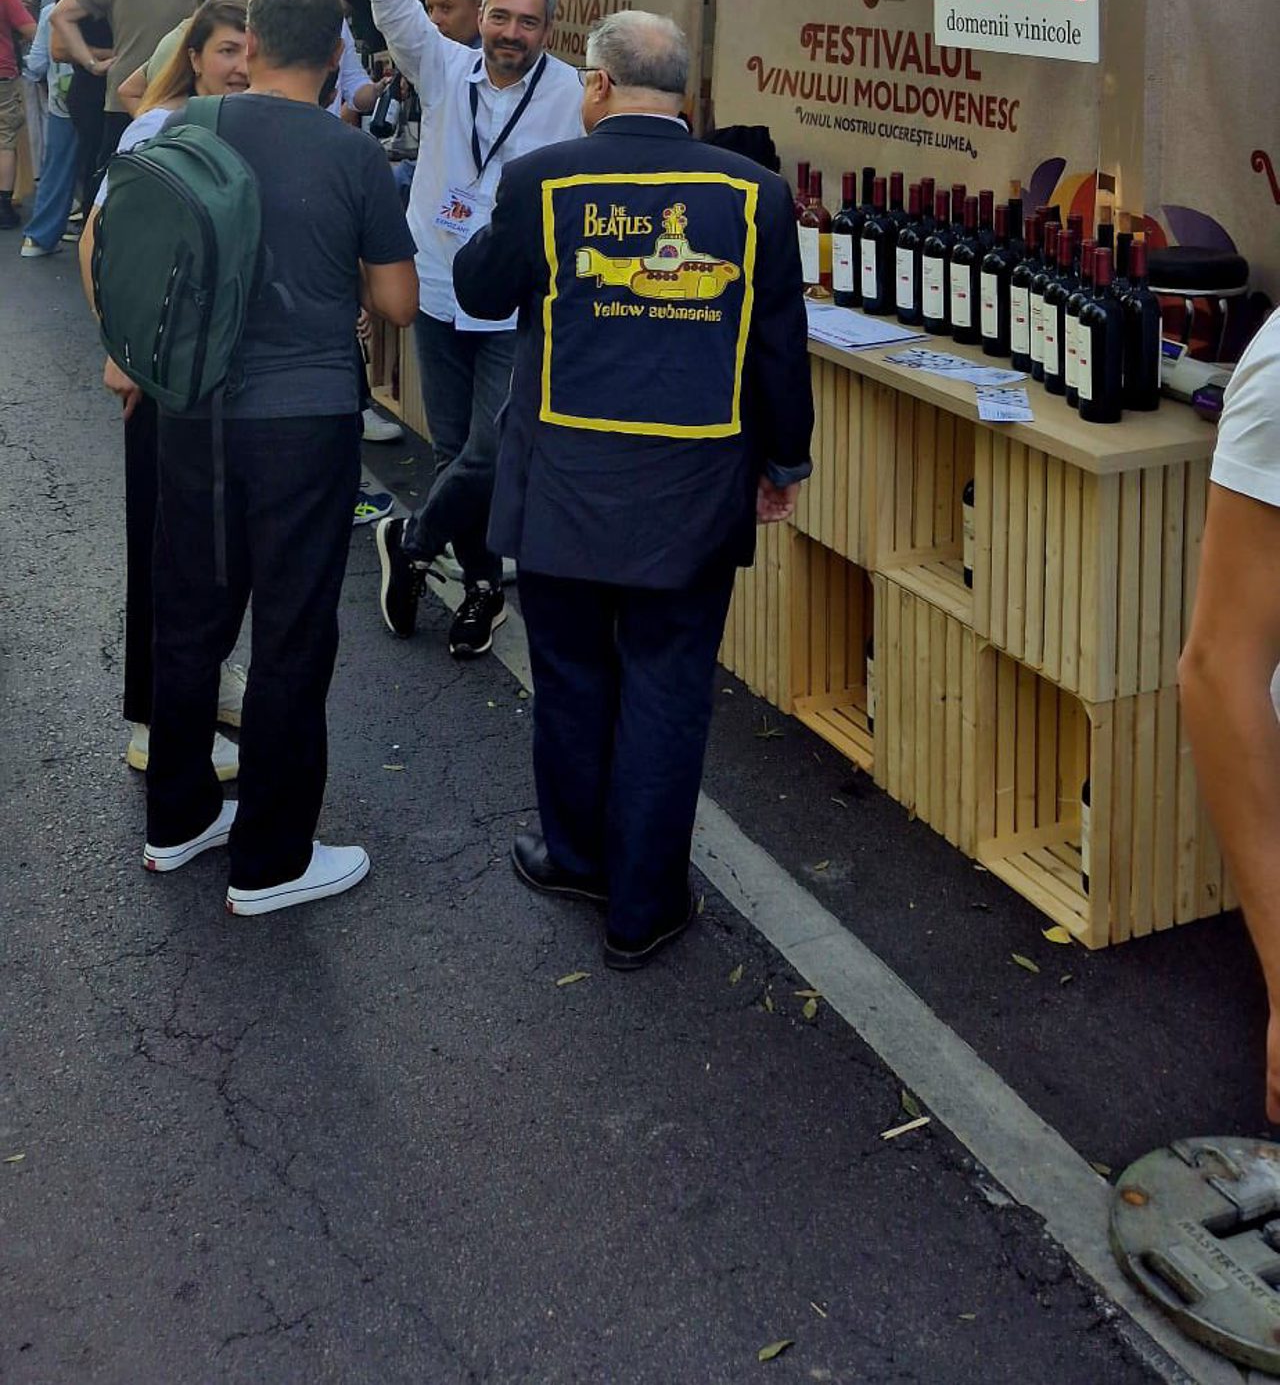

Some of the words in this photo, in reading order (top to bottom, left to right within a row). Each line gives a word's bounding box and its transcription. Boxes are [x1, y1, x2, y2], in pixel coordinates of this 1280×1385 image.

[946, 9, 1009, 37] domenii
[1014, 16, 1081, 45] vinicole
[801, 23, 981, 81] FESTIVALUL
[747, 56, 848, 104] VINULUI
[854, 78, 1020, 133] MOLDOVENESC
[796, 106, 832, 129] VINUL
[834, 115, 876, 136] NOSTRU
[935, 134, 977, 159] LUMEA
[584, 202, 653, 242] BEATLES
[610, 204, 627, 217] THE
[593, 300, 645, 318] Yellow
[1178, 1220, 1270, 1299] MASTERTENT
